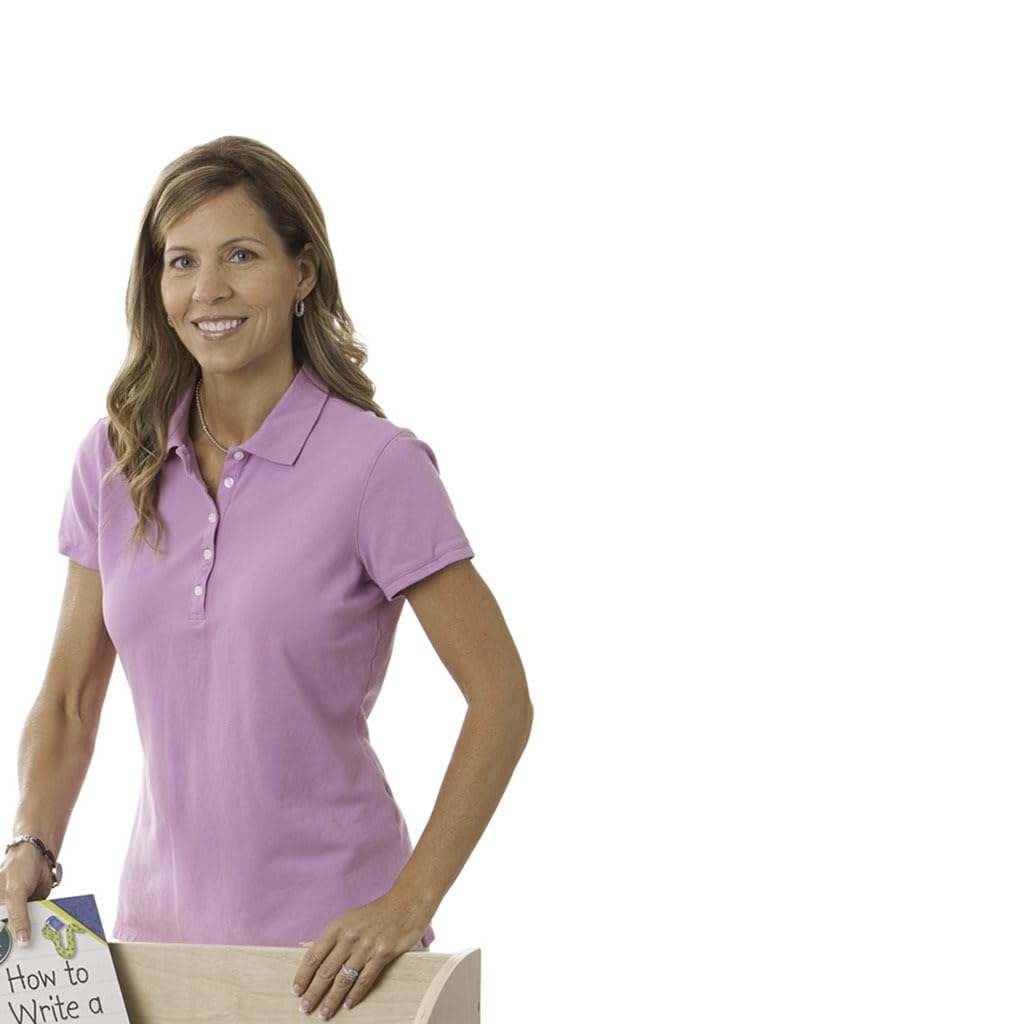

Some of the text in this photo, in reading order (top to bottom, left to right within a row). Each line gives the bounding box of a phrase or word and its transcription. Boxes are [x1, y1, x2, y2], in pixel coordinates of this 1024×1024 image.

[6, 961, 89, 993] How to
[88, 996, 103, 1015] a
